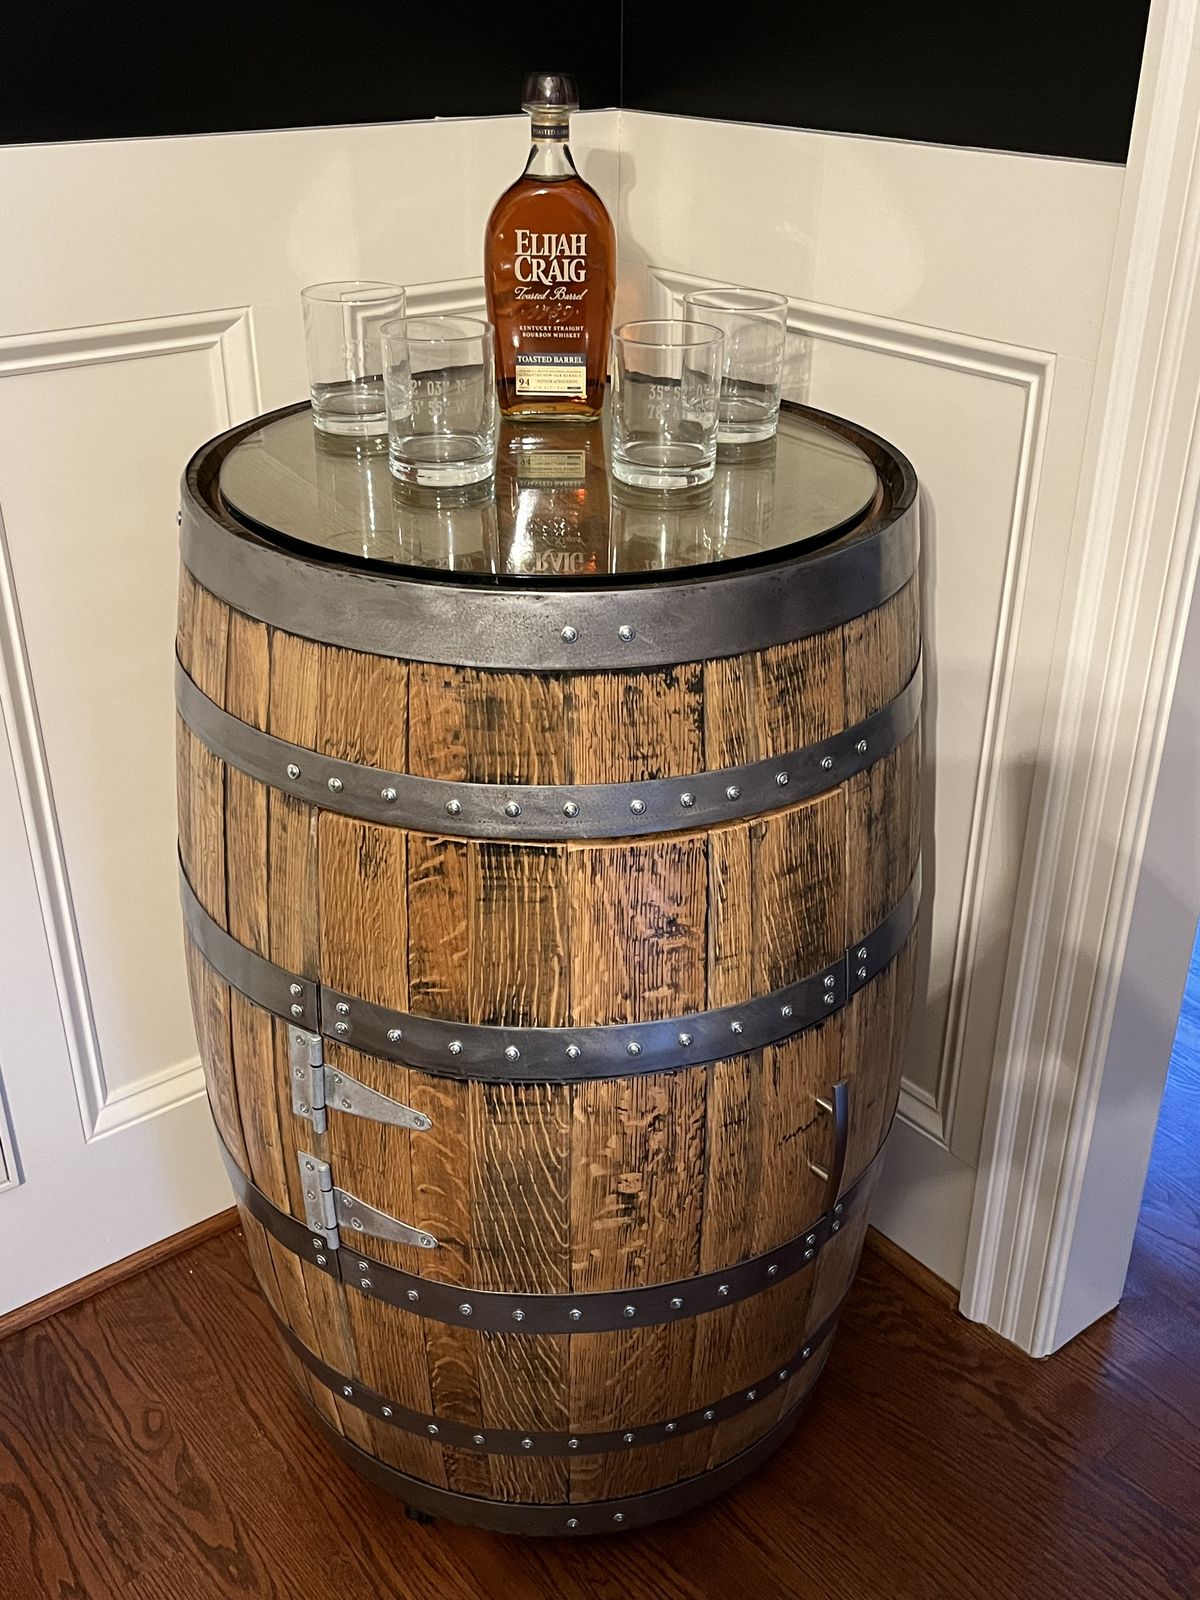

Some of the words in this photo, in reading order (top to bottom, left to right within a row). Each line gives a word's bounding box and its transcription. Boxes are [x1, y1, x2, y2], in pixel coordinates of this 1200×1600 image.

[514, 229, 587, 261] ELIJAH
[514, 255, 587, 286] CRAIG
[514, 286, 551, 300] Toasted
[549, 286, 588, 301] Barrel
[517, 355, 552, 363] TOASTED
[553, 356, 584, 364] BARREL
[518, 378, 530, 386] 94
